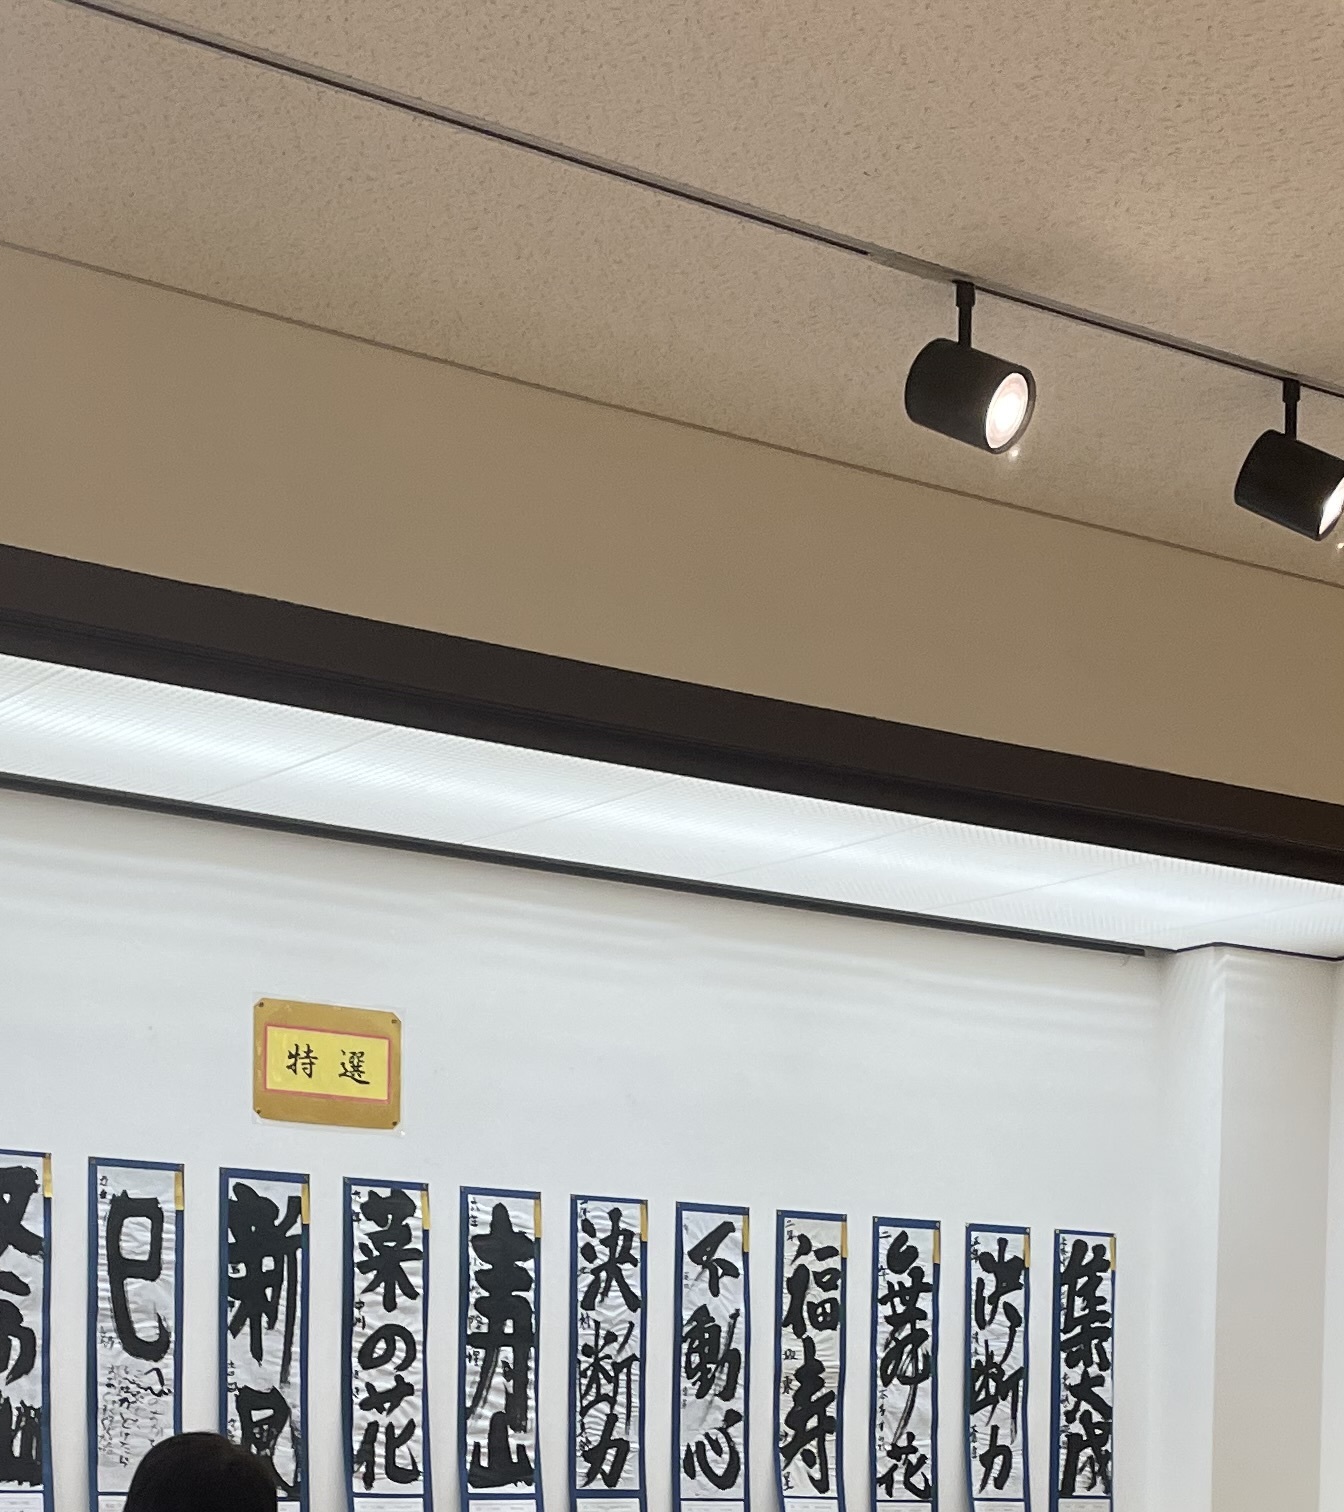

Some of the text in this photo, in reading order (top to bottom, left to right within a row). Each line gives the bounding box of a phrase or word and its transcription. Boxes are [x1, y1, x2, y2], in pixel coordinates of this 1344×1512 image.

[286, 1043, 370, 1085] 特選
[352, 1188, 424, 1491] 菜の花
[575, 1206, 642, 1488] 決断力
[682, 1220, 743, 1491] 不動心
